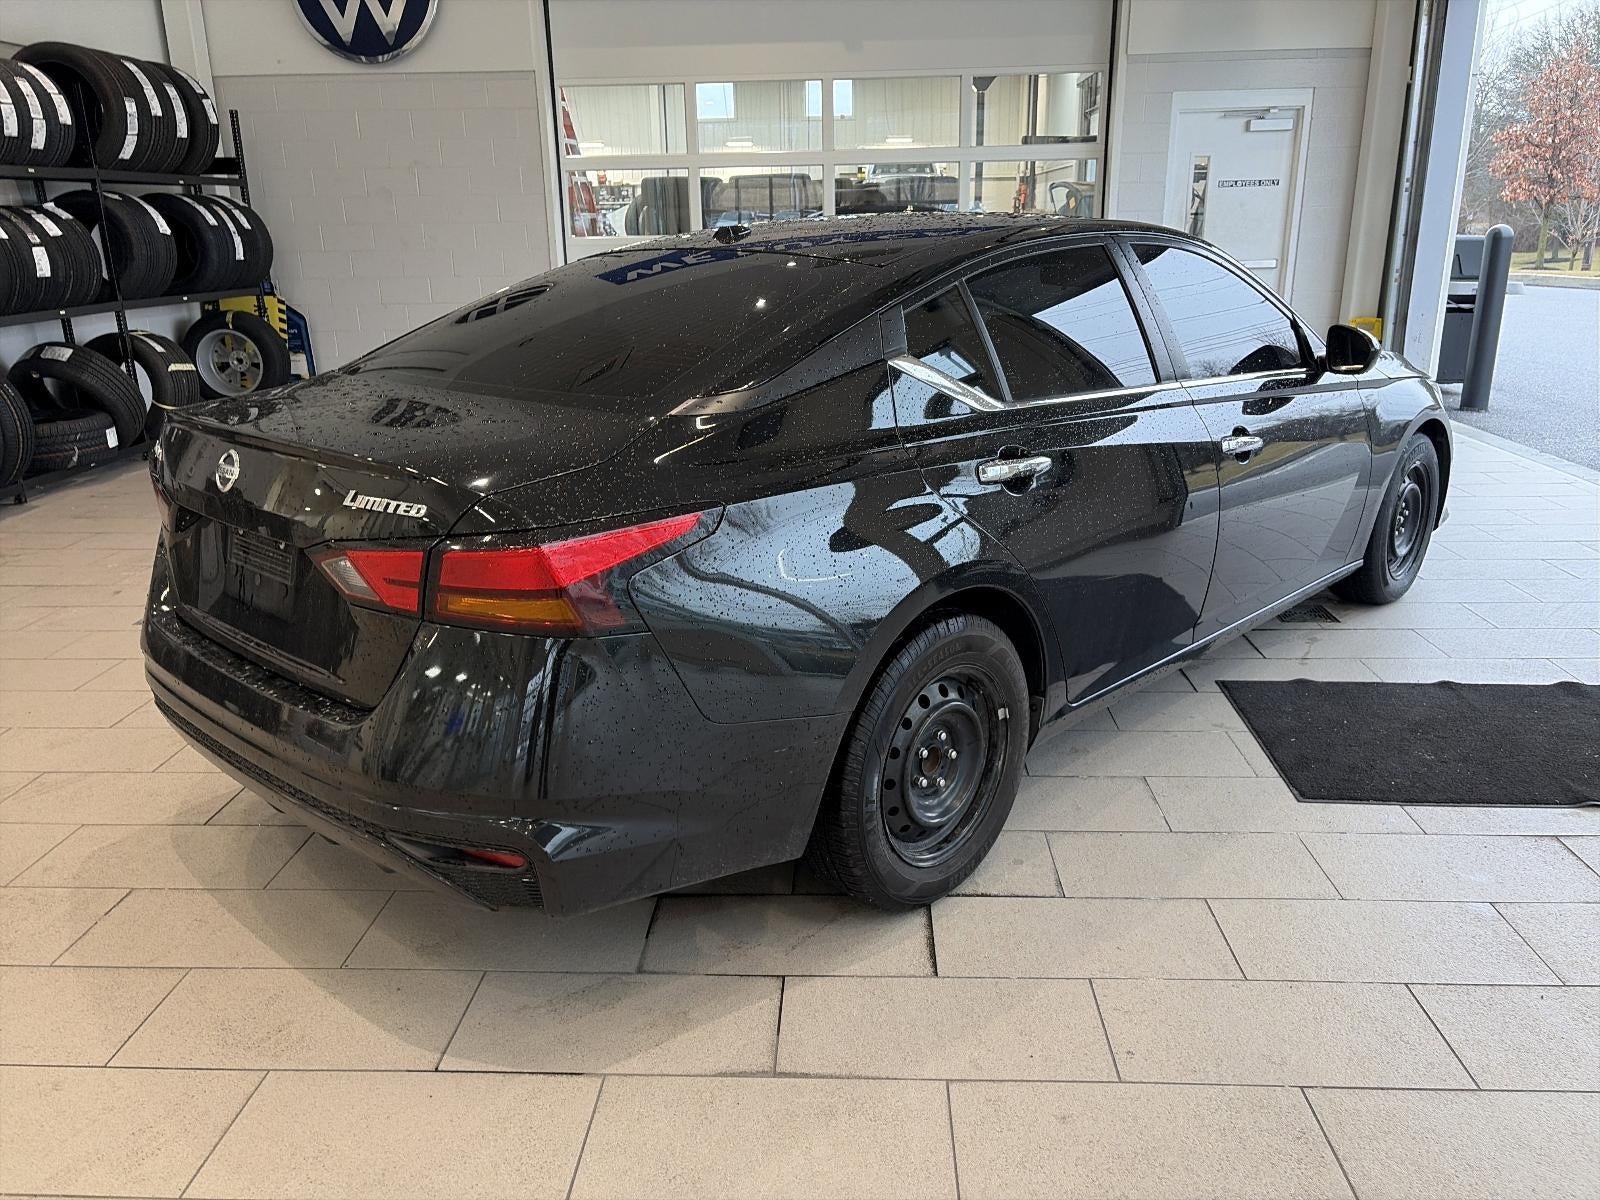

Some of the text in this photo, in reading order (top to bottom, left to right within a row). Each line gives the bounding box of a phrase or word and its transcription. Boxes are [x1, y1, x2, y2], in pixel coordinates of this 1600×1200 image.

[1219, 179, 1279, 188] EMPLOYEES ONLY
[342, 489, 428, 518] LIMITED
